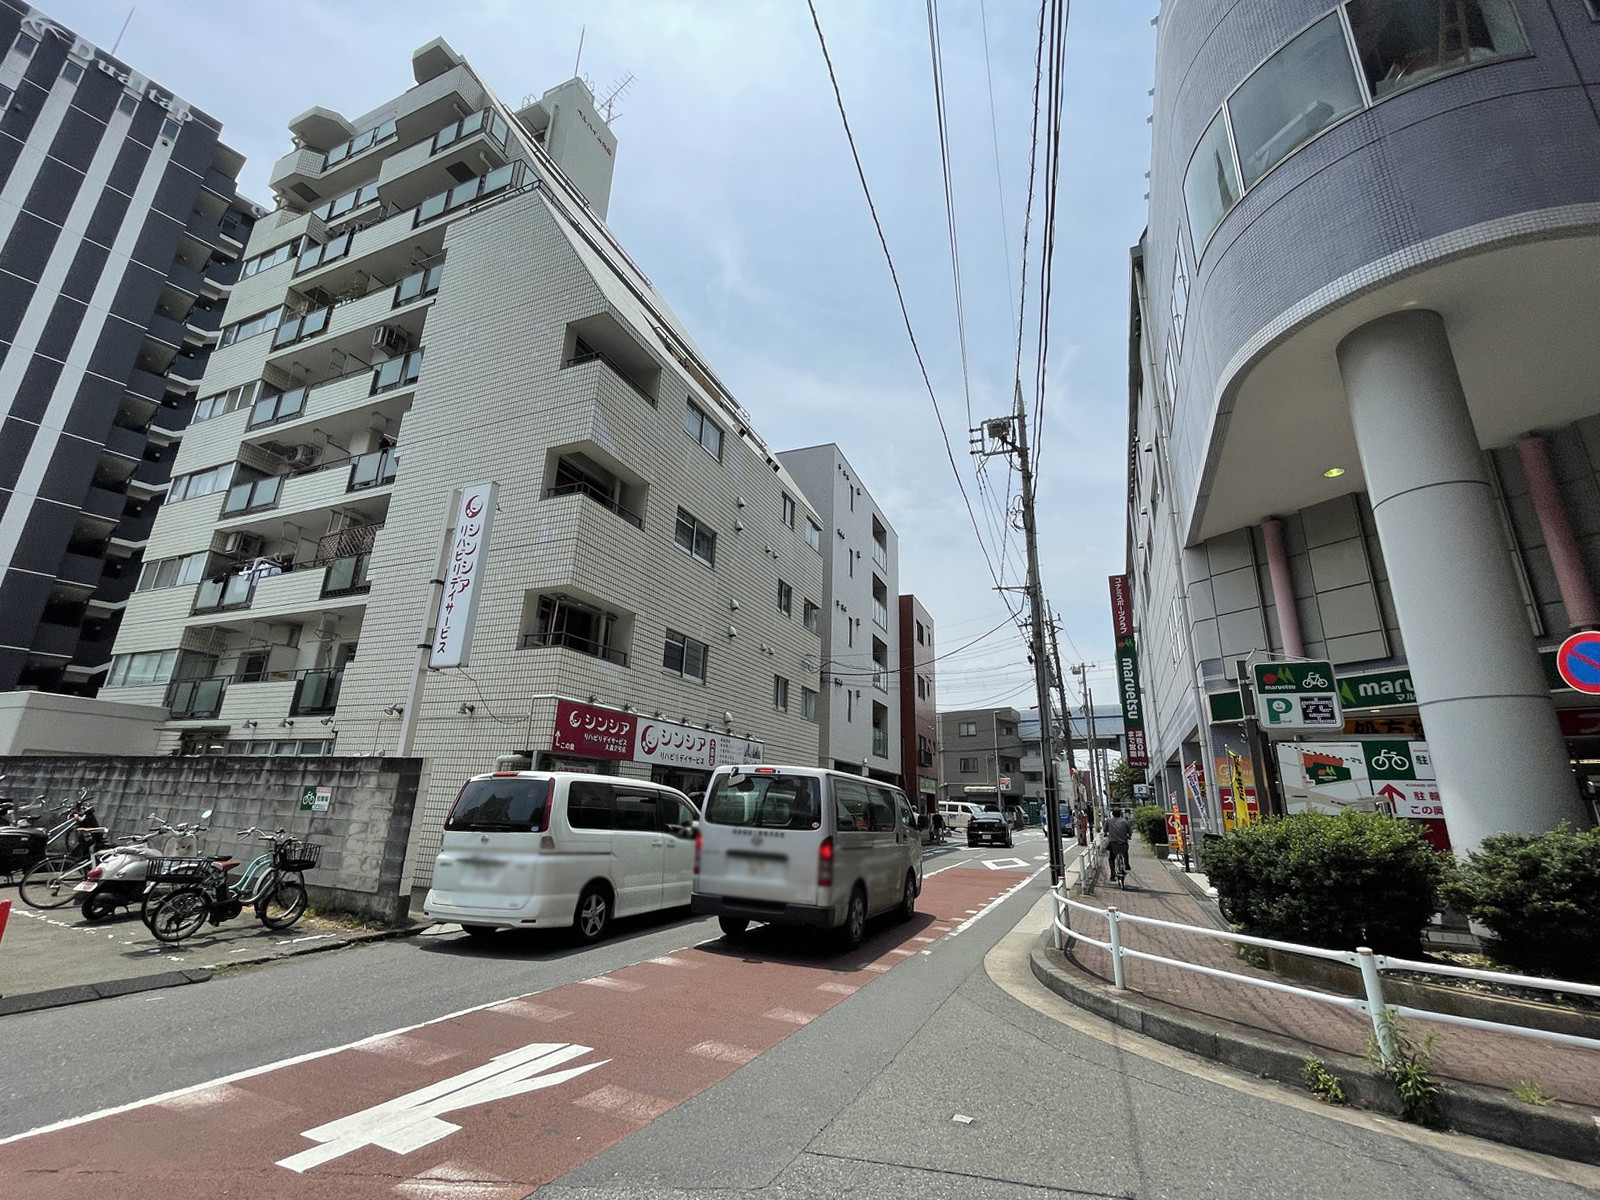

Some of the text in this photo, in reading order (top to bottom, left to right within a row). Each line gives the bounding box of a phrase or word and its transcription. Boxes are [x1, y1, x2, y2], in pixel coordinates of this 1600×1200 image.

[69, 36, 193, 122] Dualtap
[437, 524, 466, 654] リハビリデイサービス
[1115, 577, 1128, 634] コナミスポーツクラブ
[1122, 657, 1139, 719] maruetsu
[584, 714, 630, 735] シンシア
[584, 732, 628, 746] リハビリデイサービス
[661, 729, 706, 752] シンシア
[660, 752, 705, 766] リハビリデイサービス
